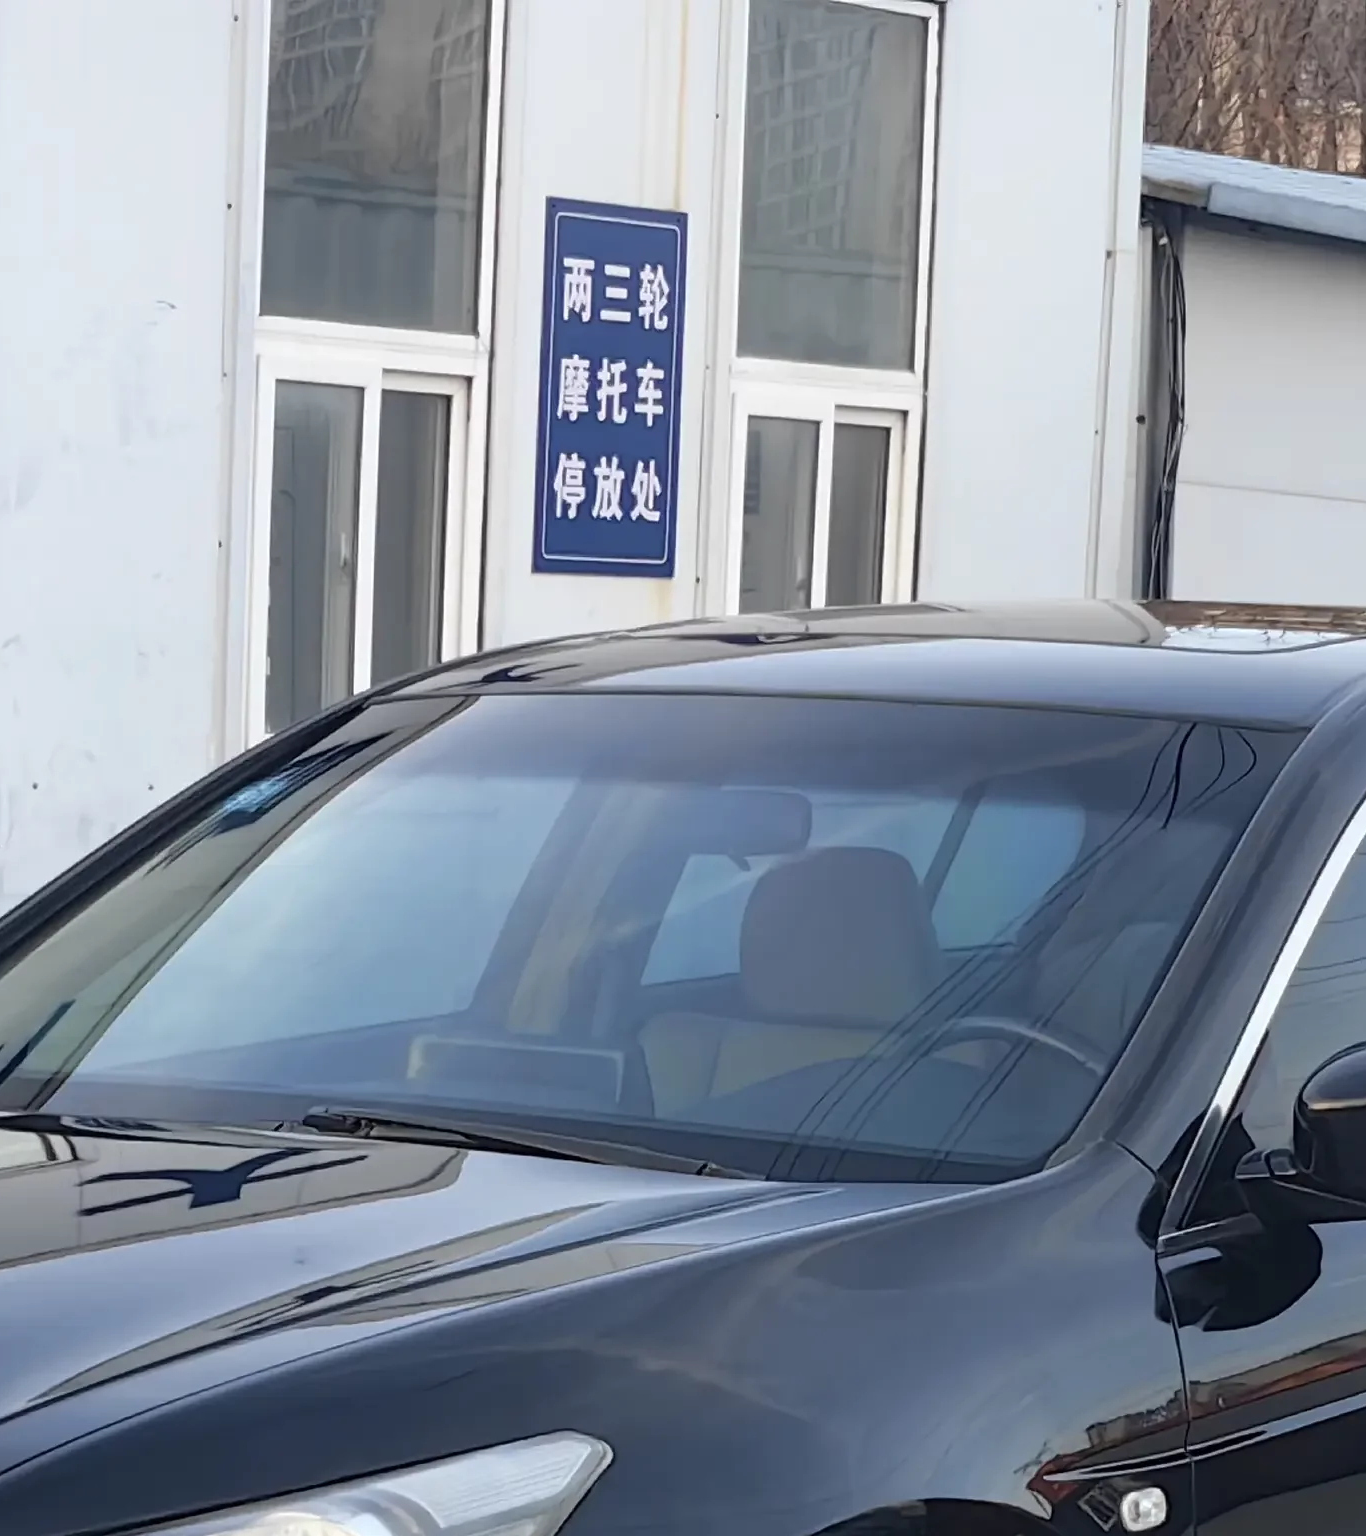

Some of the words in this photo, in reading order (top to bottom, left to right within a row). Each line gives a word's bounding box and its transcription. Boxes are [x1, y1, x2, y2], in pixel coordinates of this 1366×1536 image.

[563, 257, 670, 330] 两三轮
[557, 354, 665, 427] 摩托车
[553, 452, 662, 522] 停放处
